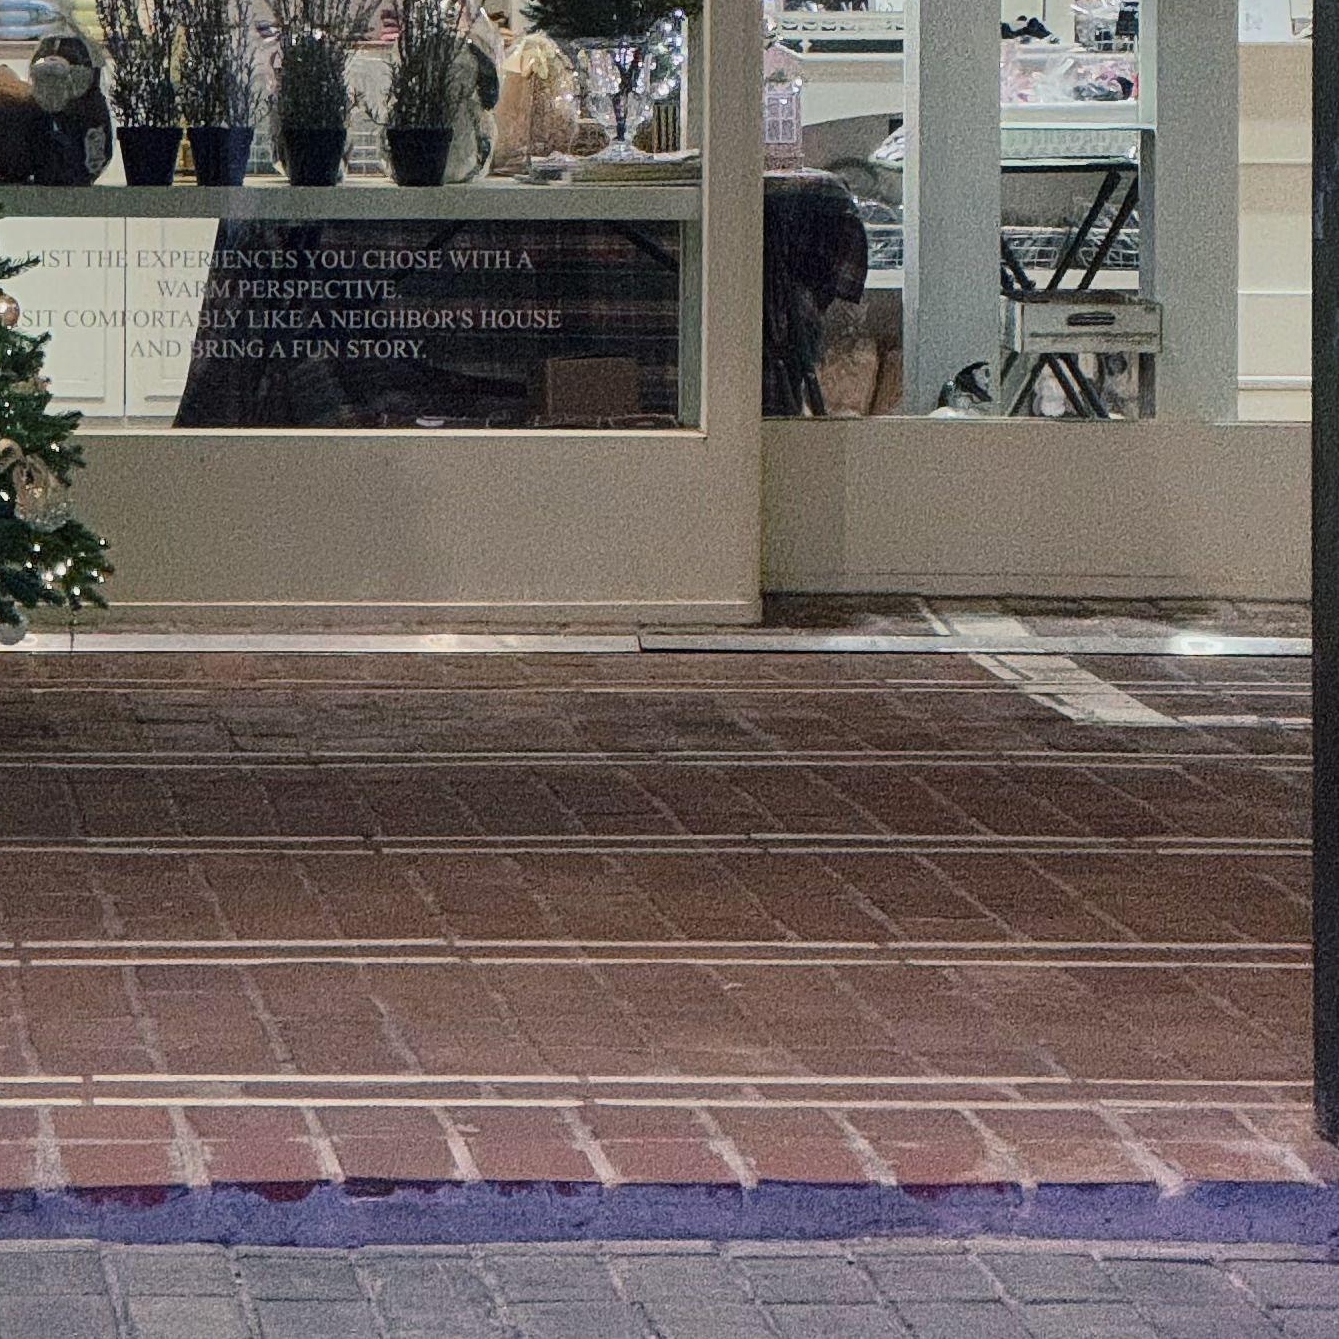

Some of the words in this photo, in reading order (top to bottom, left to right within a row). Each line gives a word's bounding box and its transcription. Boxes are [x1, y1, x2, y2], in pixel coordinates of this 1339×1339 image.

[82, 249, 128, 269] THE
[136, 249, 299, 270] EXPERIENCES
[304, 249, 357, 270] YOU
[363, 249, 443, 270] CHOSE
[449, 249, 512, 270] WITH
[516, 249, 534, 270] A
[157, 279, 231, 299] WARM
[238, 279, 403, 300] PERSPECTIVE.
[63, 308, 242, 330] COMFORTABLY
[247, 309, 305, 329] LIKE
[308, 309, 326, 329] A
[329, 309, 475, 330] NEIGHBOR'S
[480, 309, 563, 330] HOUSE
[129, 339, 182, 359] AND
[192, 339, 264, 359] BRING
[268, 339, 287, 359] A
[292, 339, 341, 359] FUN
[346, 339, 428, 360] STORY.
